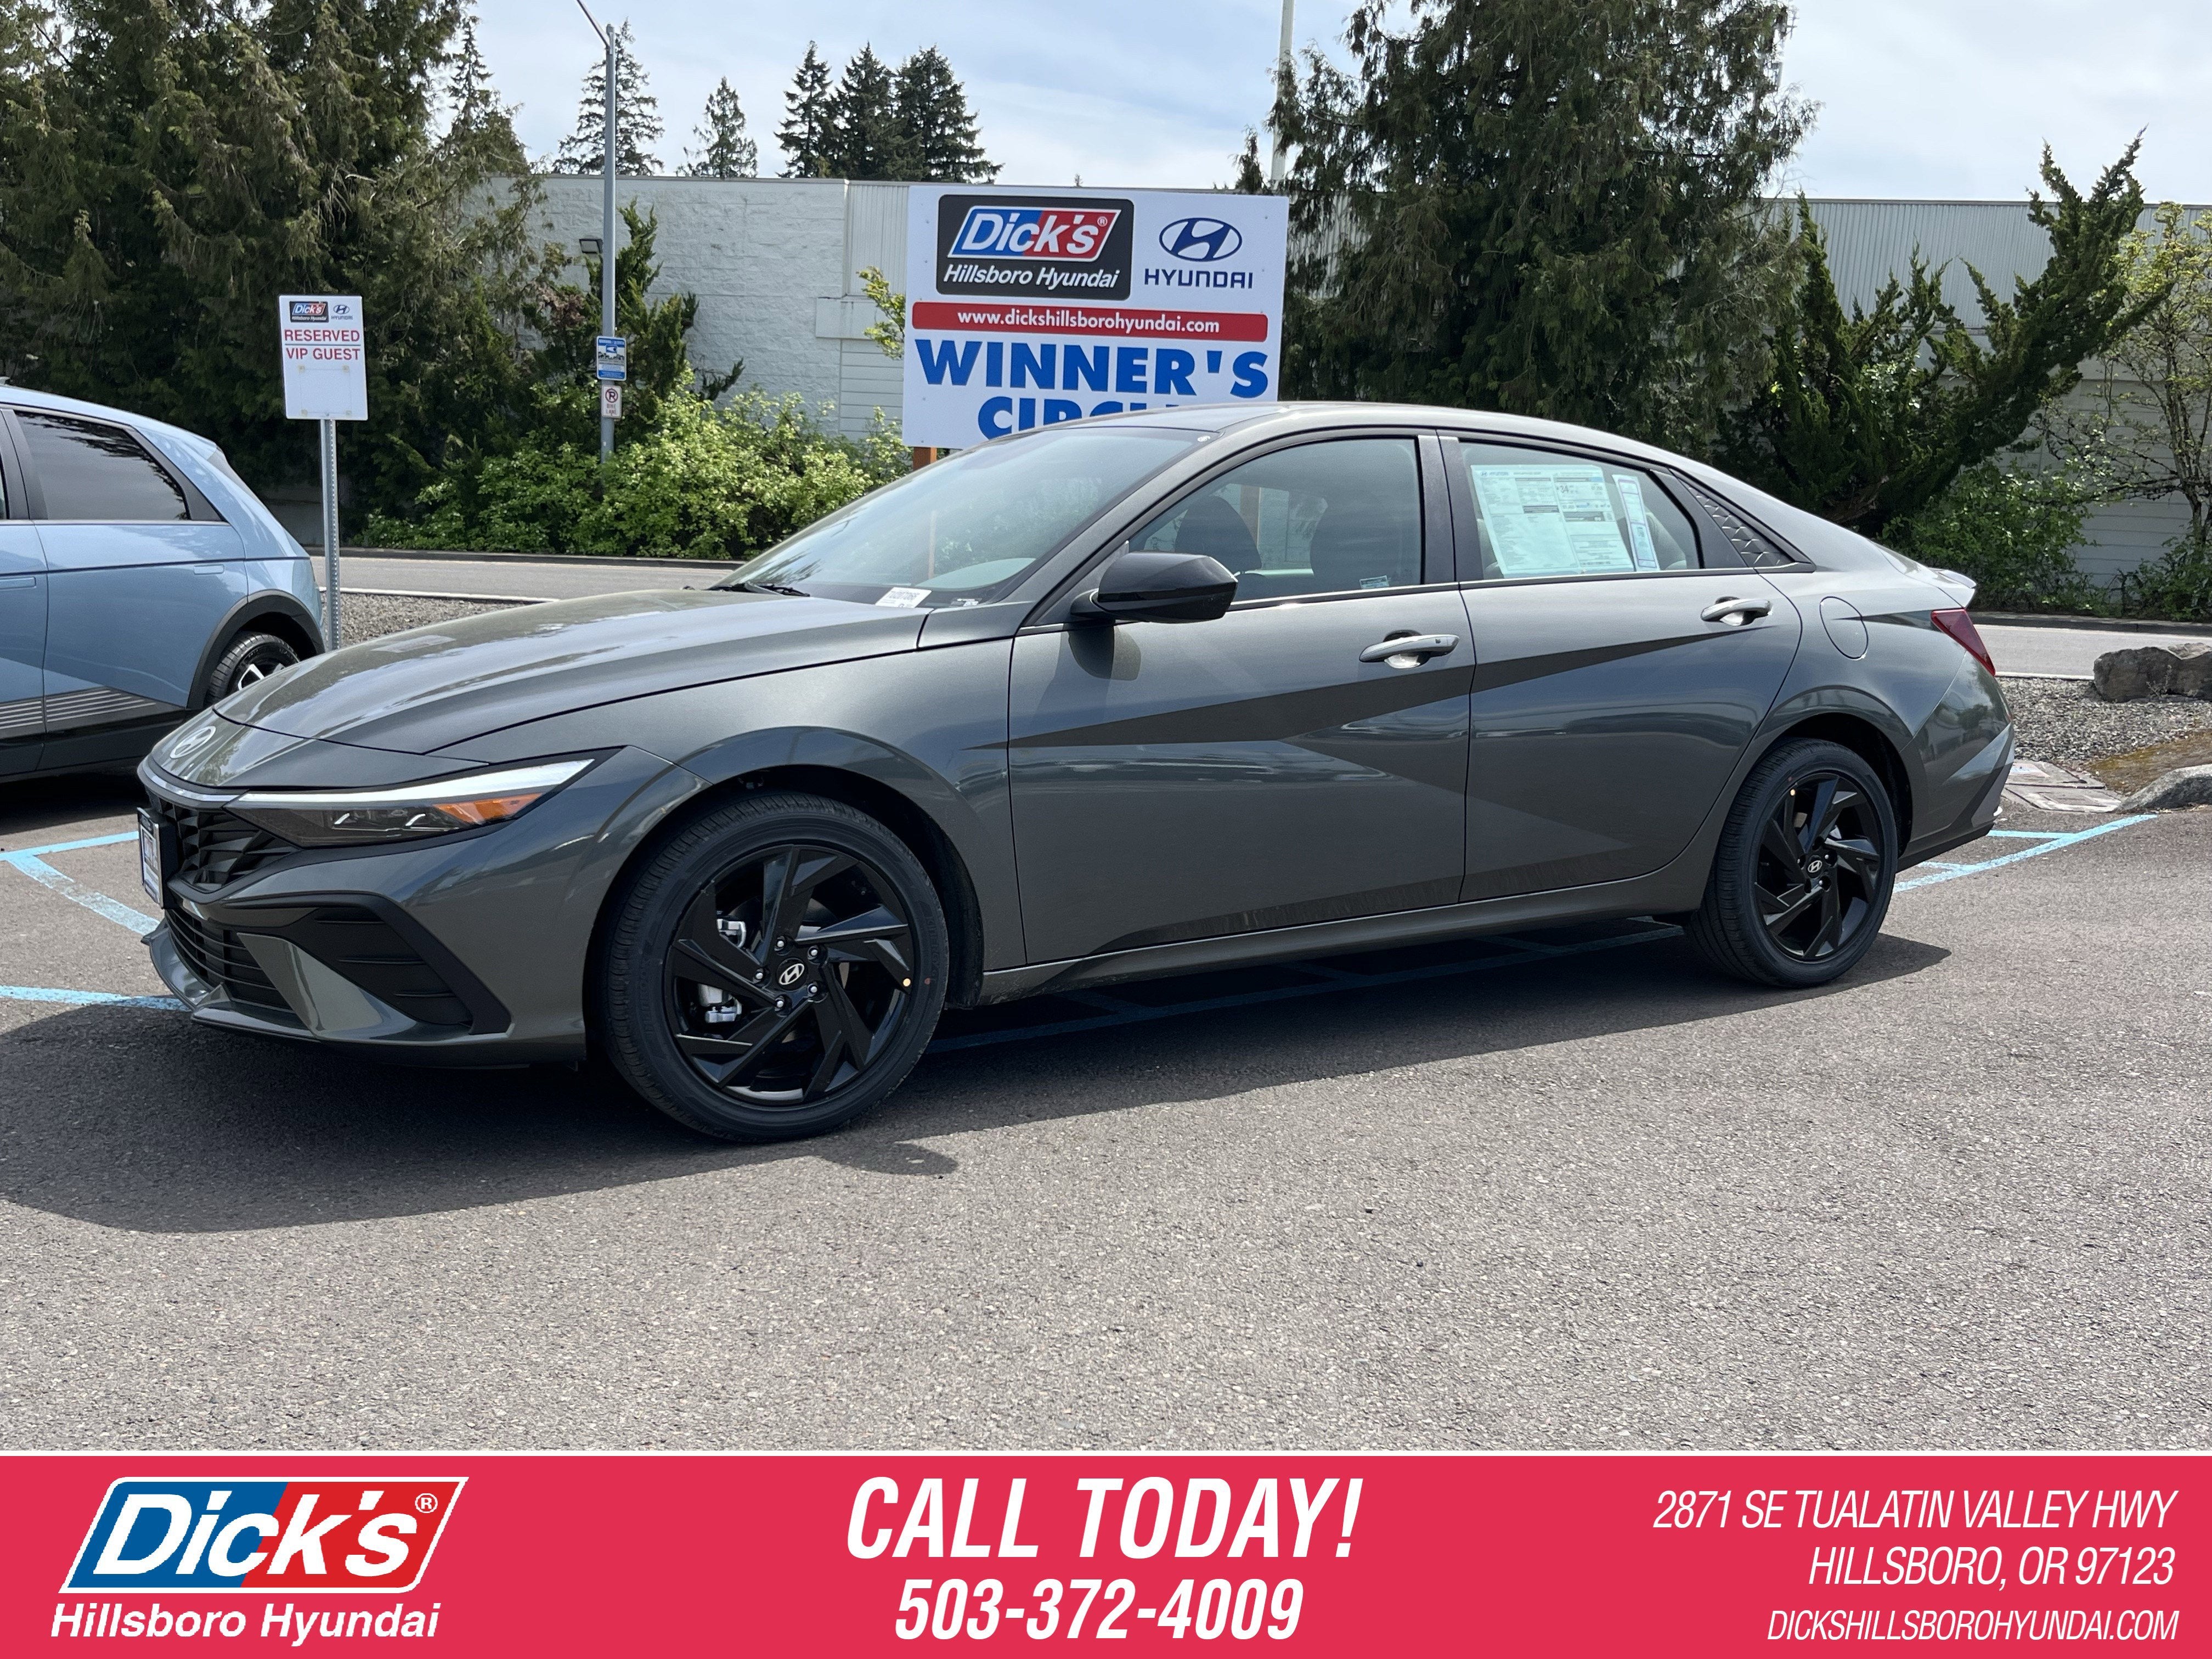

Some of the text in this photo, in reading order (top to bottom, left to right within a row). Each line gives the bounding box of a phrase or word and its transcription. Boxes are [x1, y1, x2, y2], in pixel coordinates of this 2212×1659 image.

[961, 212, 1098, 255] Dick's
[943, 264, 1120, 290] Hillsboro Hyundai
[1143, 268, 1253, 289] HYUNDAI
[957, 309, 1220, 335] www.dickshillsborohyundai.com
[284, 329, 360, 342] RESERVED
[286, 347, 361, 360] VIP GUEST
[915, 338, 1268, 398] WINNER'S
